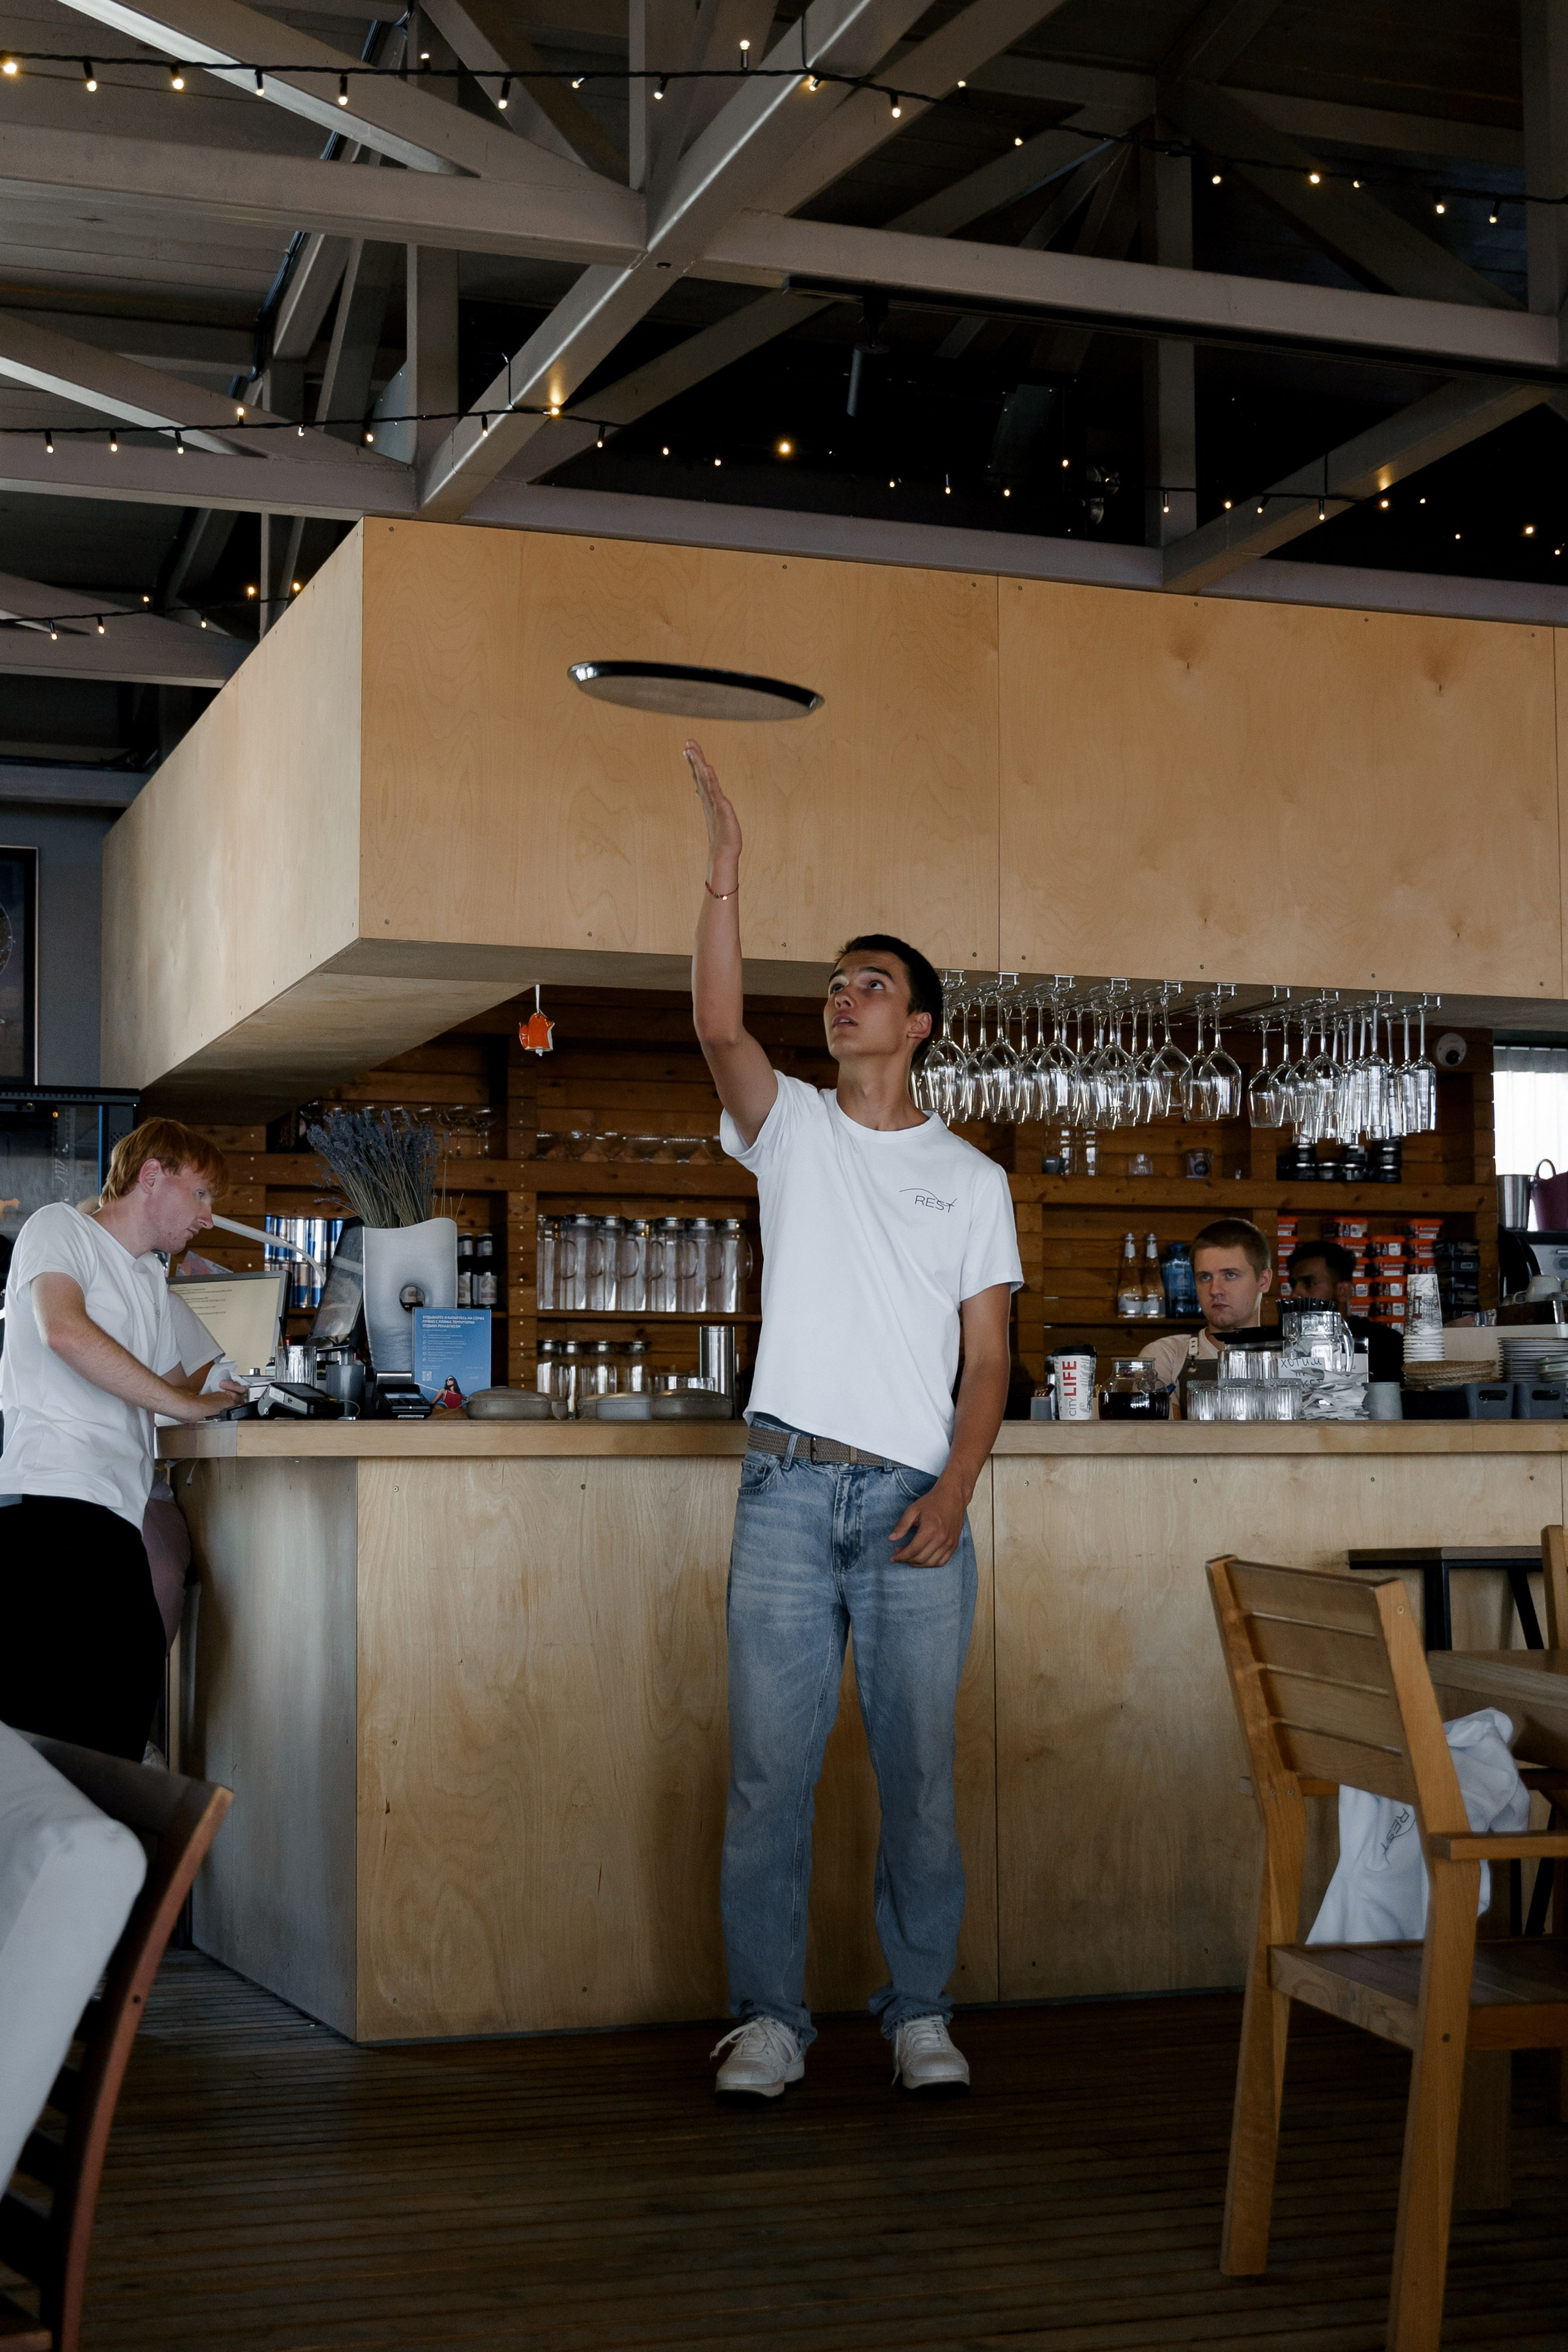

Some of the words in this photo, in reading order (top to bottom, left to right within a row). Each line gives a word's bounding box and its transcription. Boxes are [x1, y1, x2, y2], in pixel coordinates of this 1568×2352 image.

[914, 1195, 954, 1213] REST
[1062, 1361, 1077, 1396] LIFE
[1381, 1807, 1410, 1855] REST
